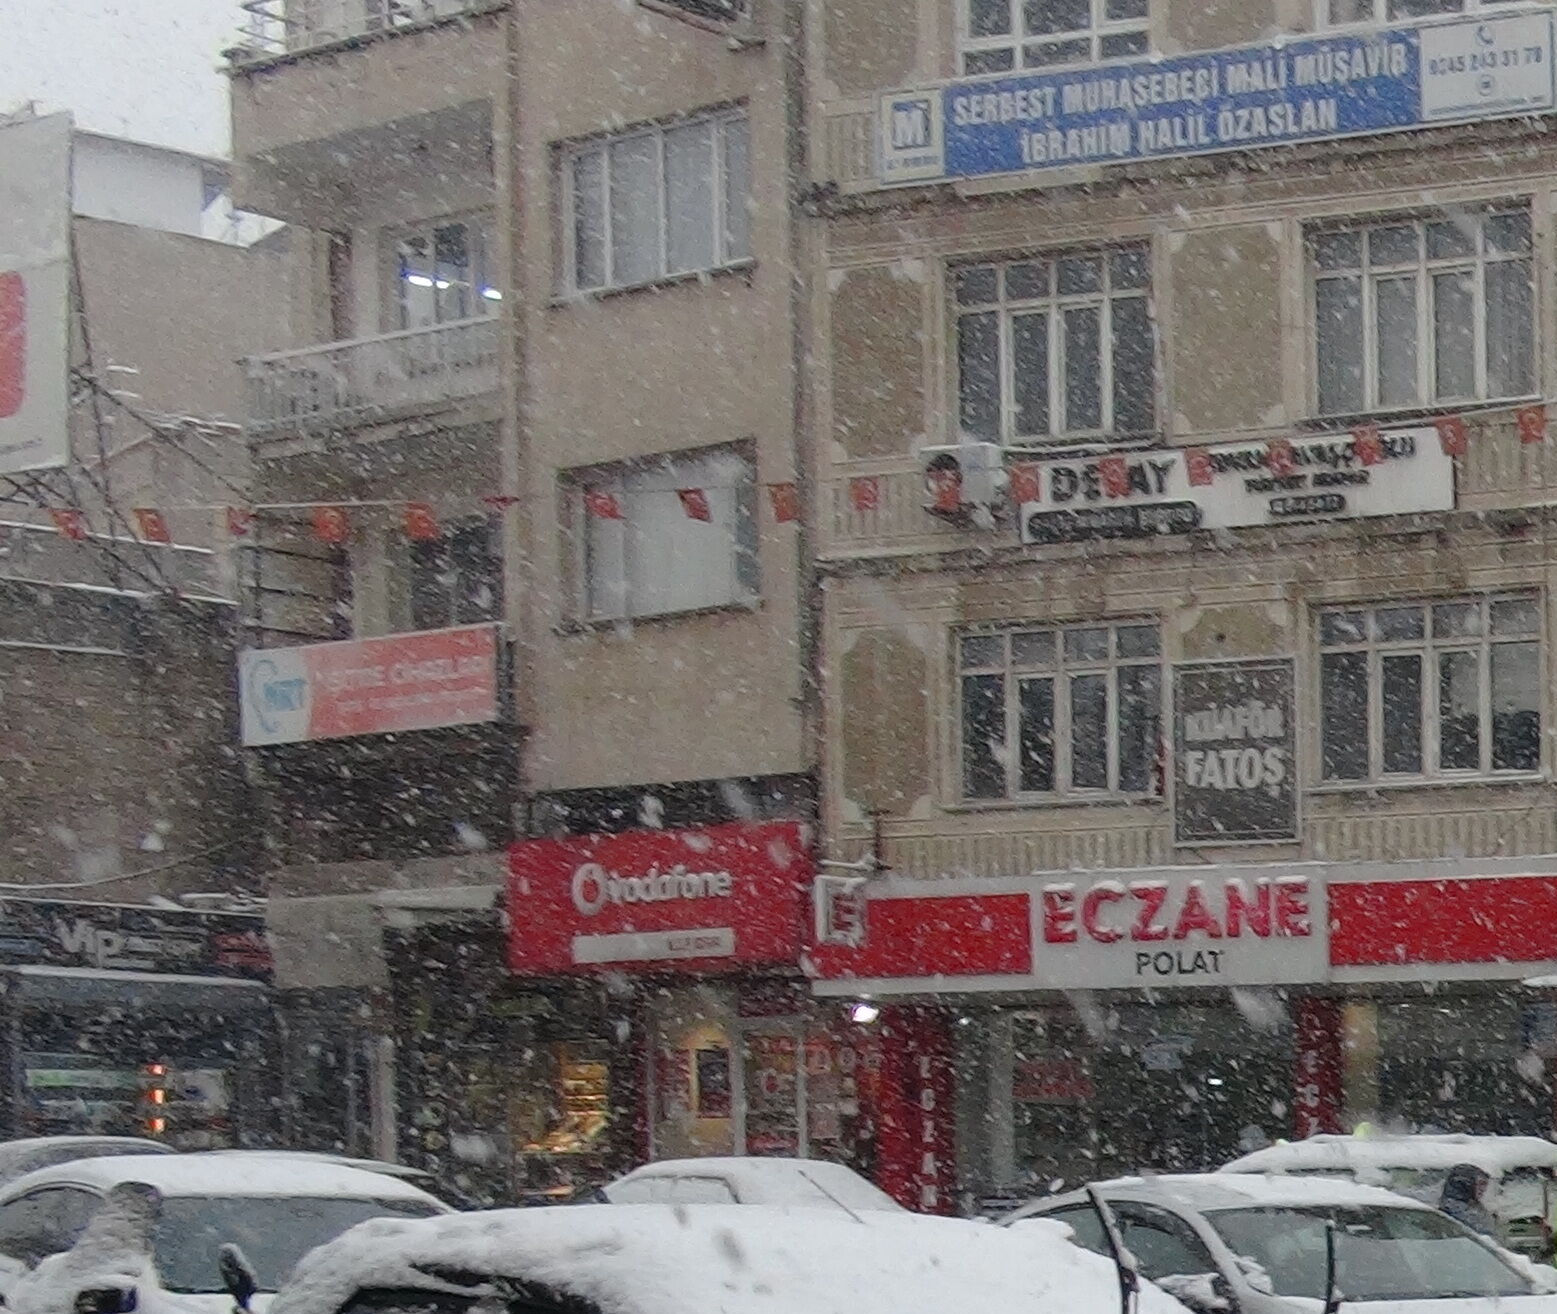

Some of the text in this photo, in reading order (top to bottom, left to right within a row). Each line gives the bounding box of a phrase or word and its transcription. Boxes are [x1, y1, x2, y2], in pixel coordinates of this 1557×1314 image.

[951, 86, 1056, 126] SERBEST
[1042, 880, 1312, 943] ECZANE
[1135, 951, 1223, 976] POLAT
